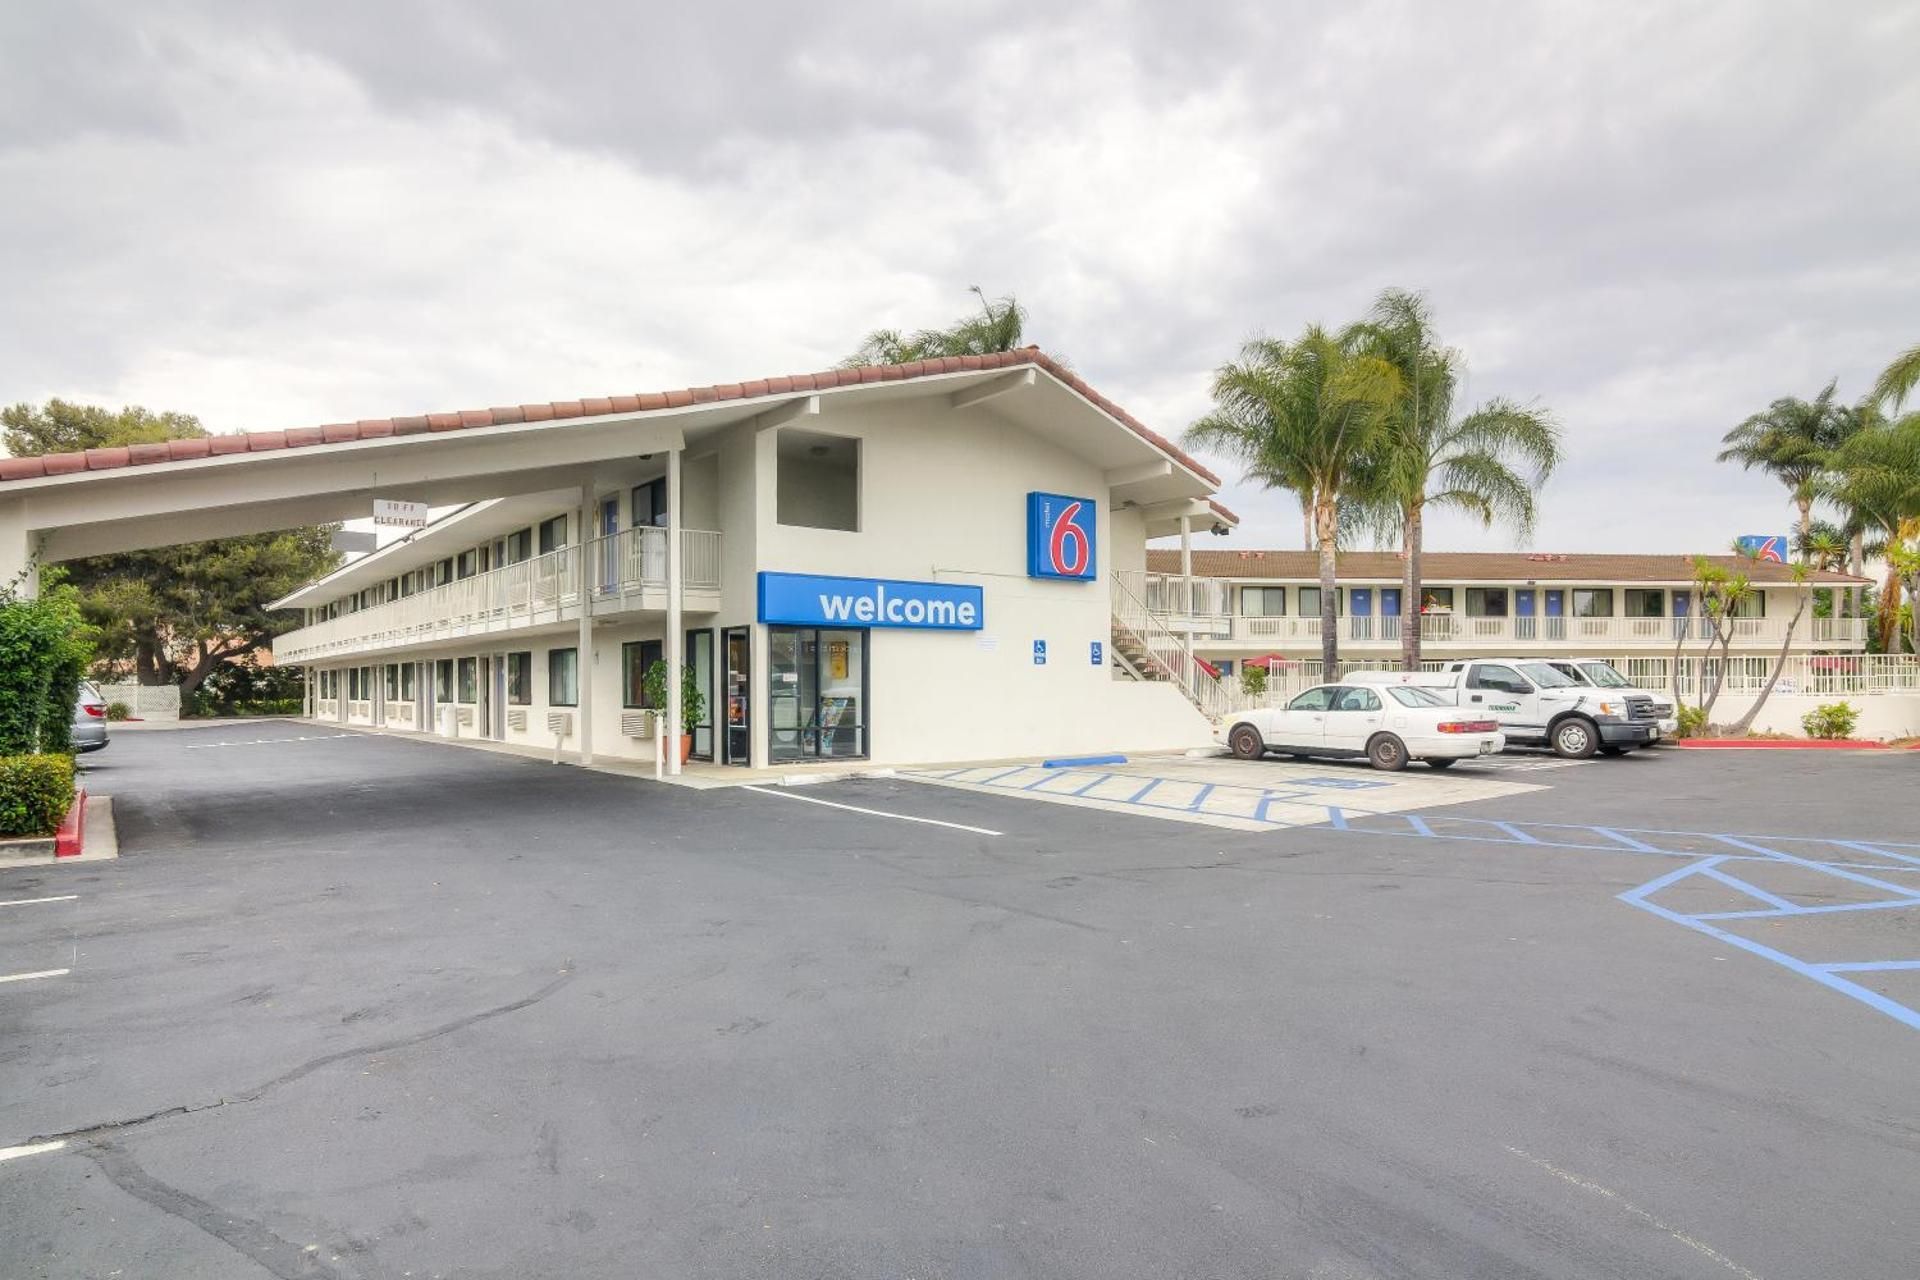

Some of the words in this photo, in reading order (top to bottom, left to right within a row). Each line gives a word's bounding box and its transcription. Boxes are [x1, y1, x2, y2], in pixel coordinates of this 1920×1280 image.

[374, 516, 426, 527] CLEARANCE
[1050, 501, 1089, 575] 6
[819, 585, 975, 625] welcome
